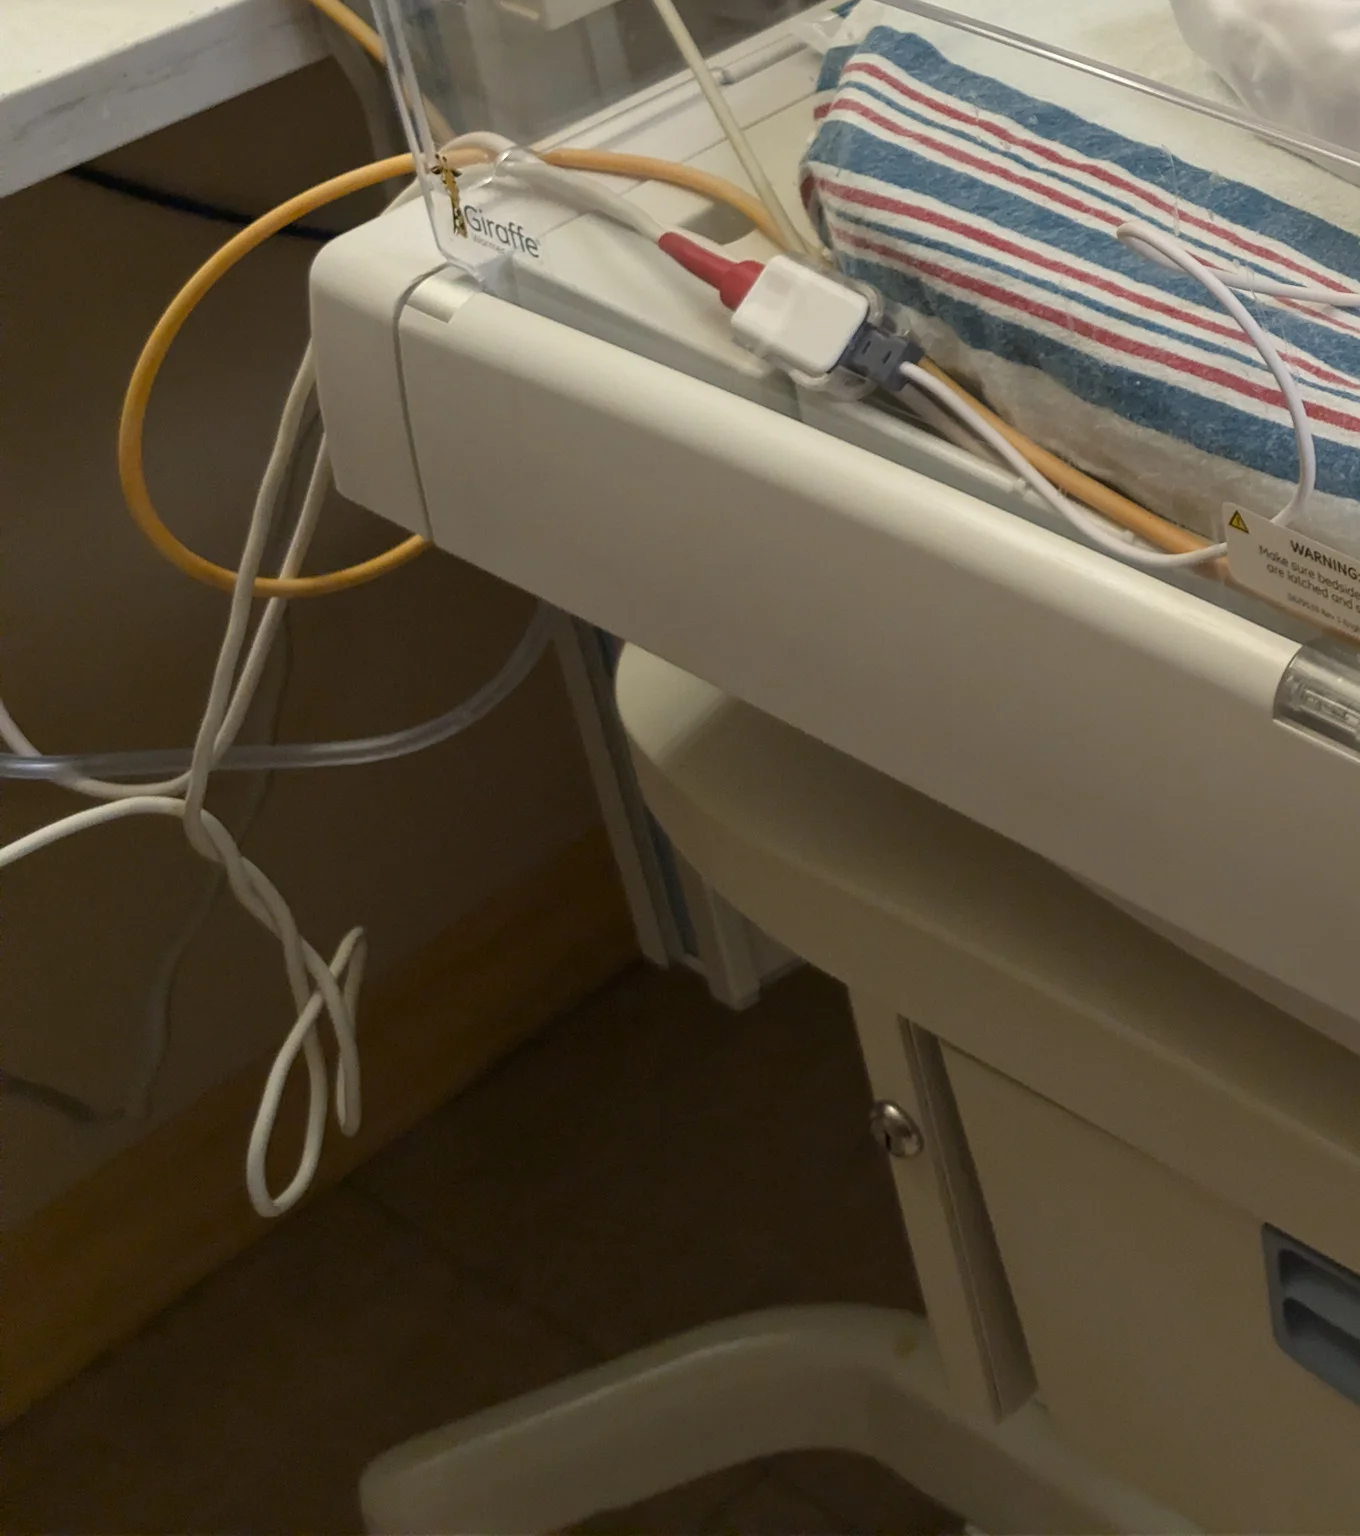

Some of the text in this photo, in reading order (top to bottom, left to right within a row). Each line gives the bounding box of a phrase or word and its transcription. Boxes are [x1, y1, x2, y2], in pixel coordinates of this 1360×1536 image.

[464, 205, 540, 258] Giraffe
[1258, 544, 1289, 568] Make
[1291, 561, 1316, 579] sure
[1266, 563, 1285, 578] are
[1287, 571, 1330, 600] latched
[1331, 593, 1353, 610] and
